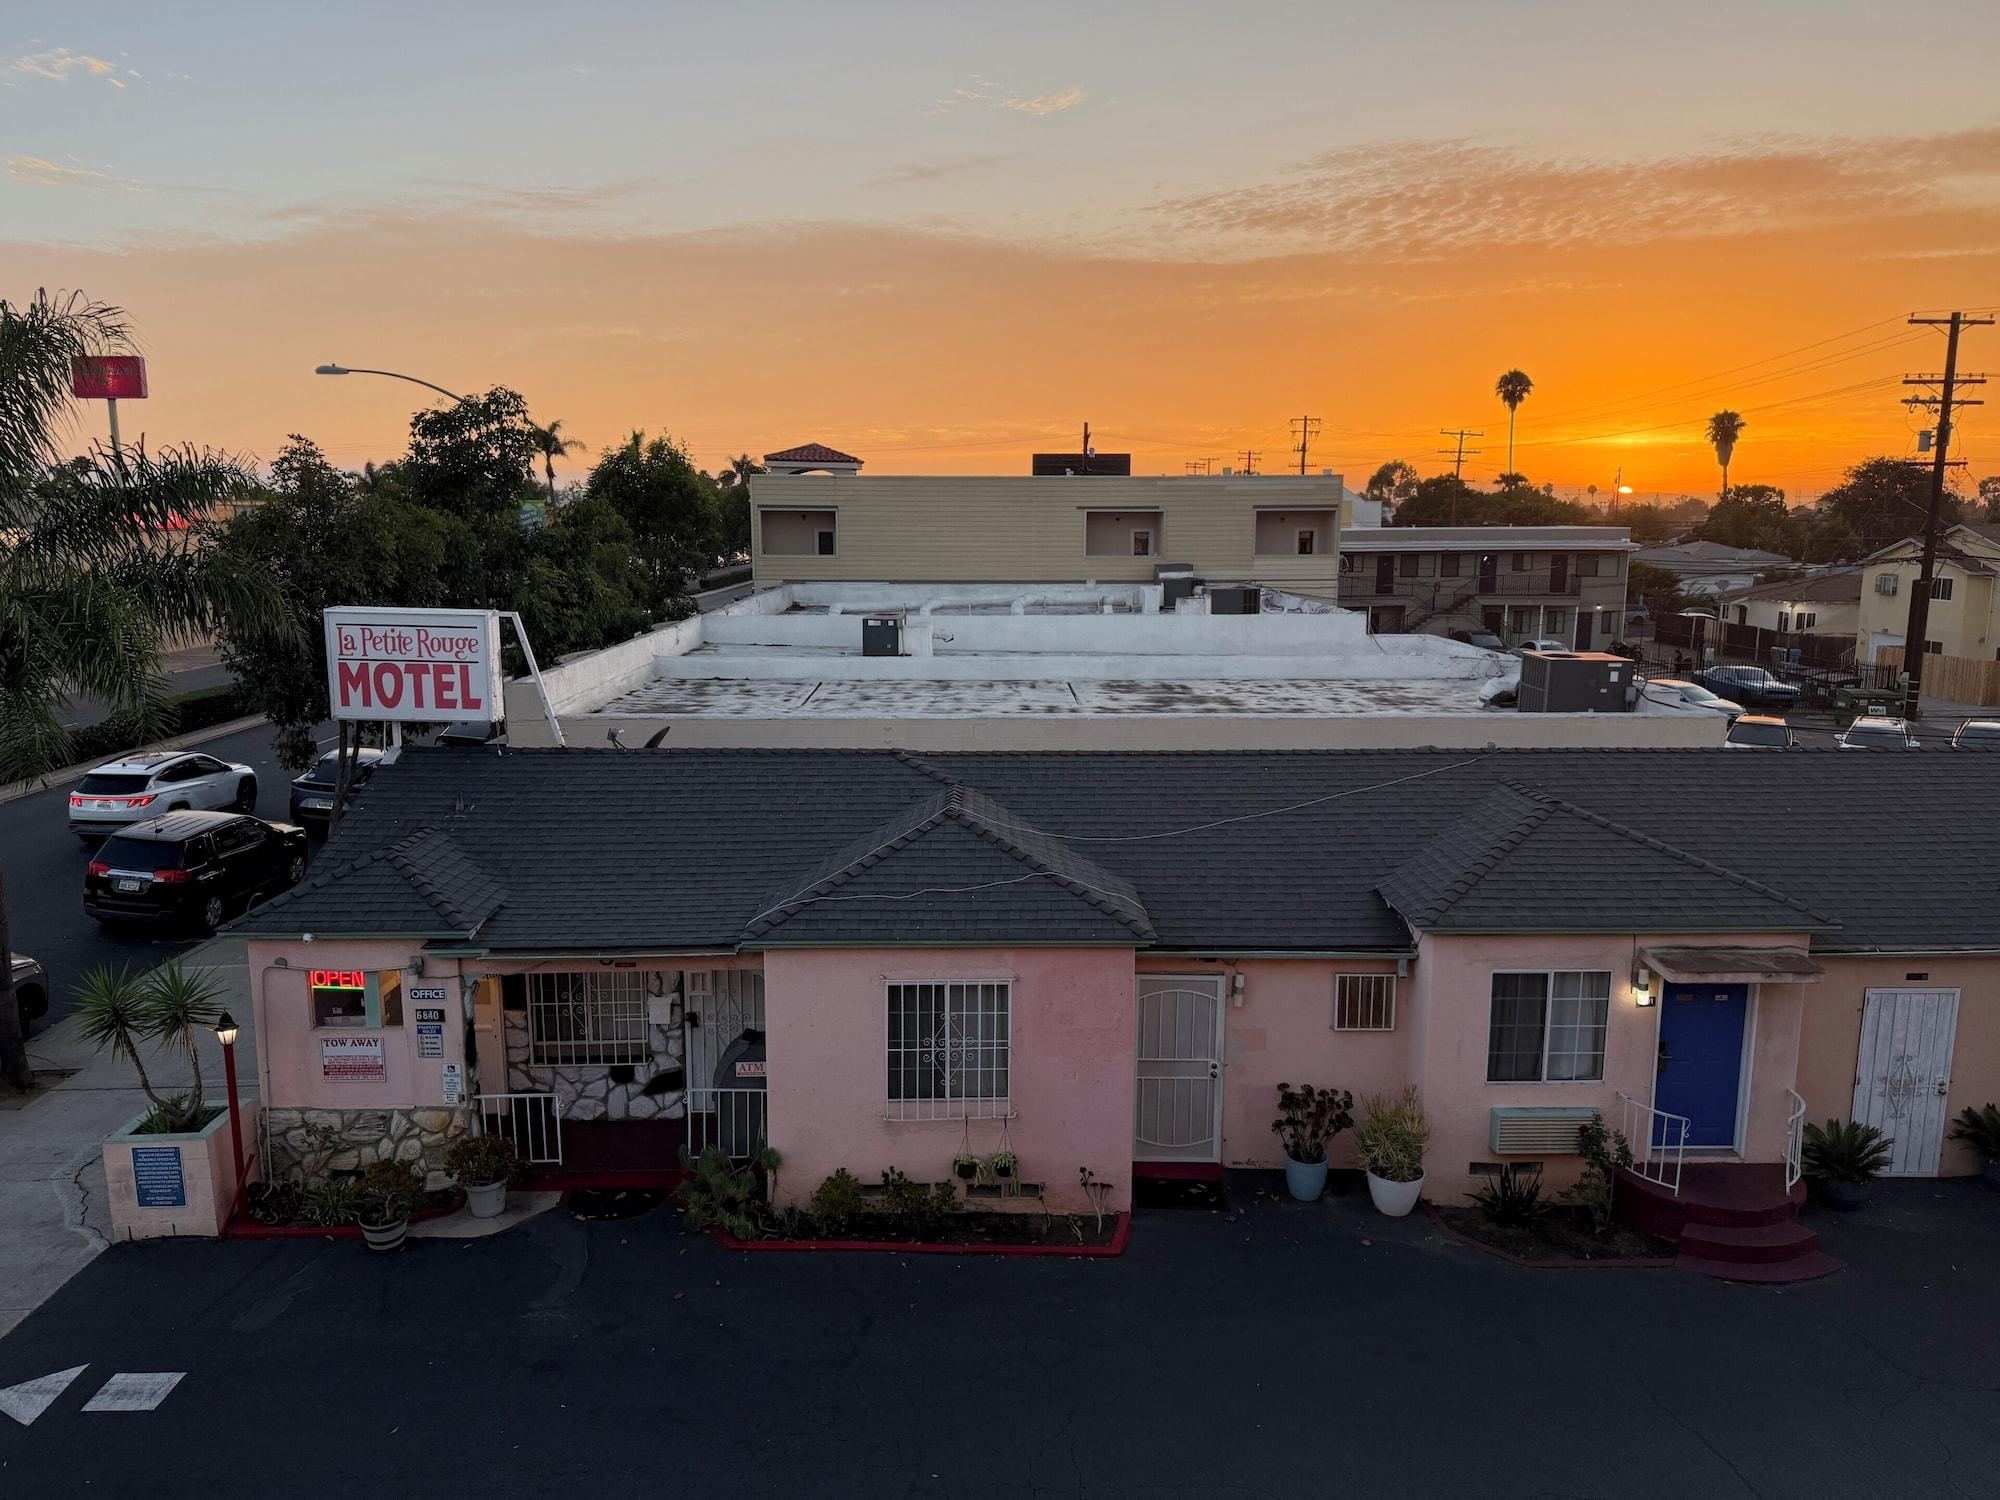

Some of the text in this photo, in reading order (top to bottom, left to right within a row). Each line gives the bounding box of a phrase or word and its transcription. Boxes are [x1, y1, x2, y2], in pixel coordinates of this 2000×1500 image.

[336, 626, 479, 660] La Petite Rouge
[338, 662, 482, 710] MOTEL
[313, 970, 365, 987] OPEN
[411, 989, 445, 999] OFFICE
[416, 1011, 439, 1020] 6840
[323, 1039, 379, 1047] TOW AWAY
[740, 1063, 764, 1071] ATM
